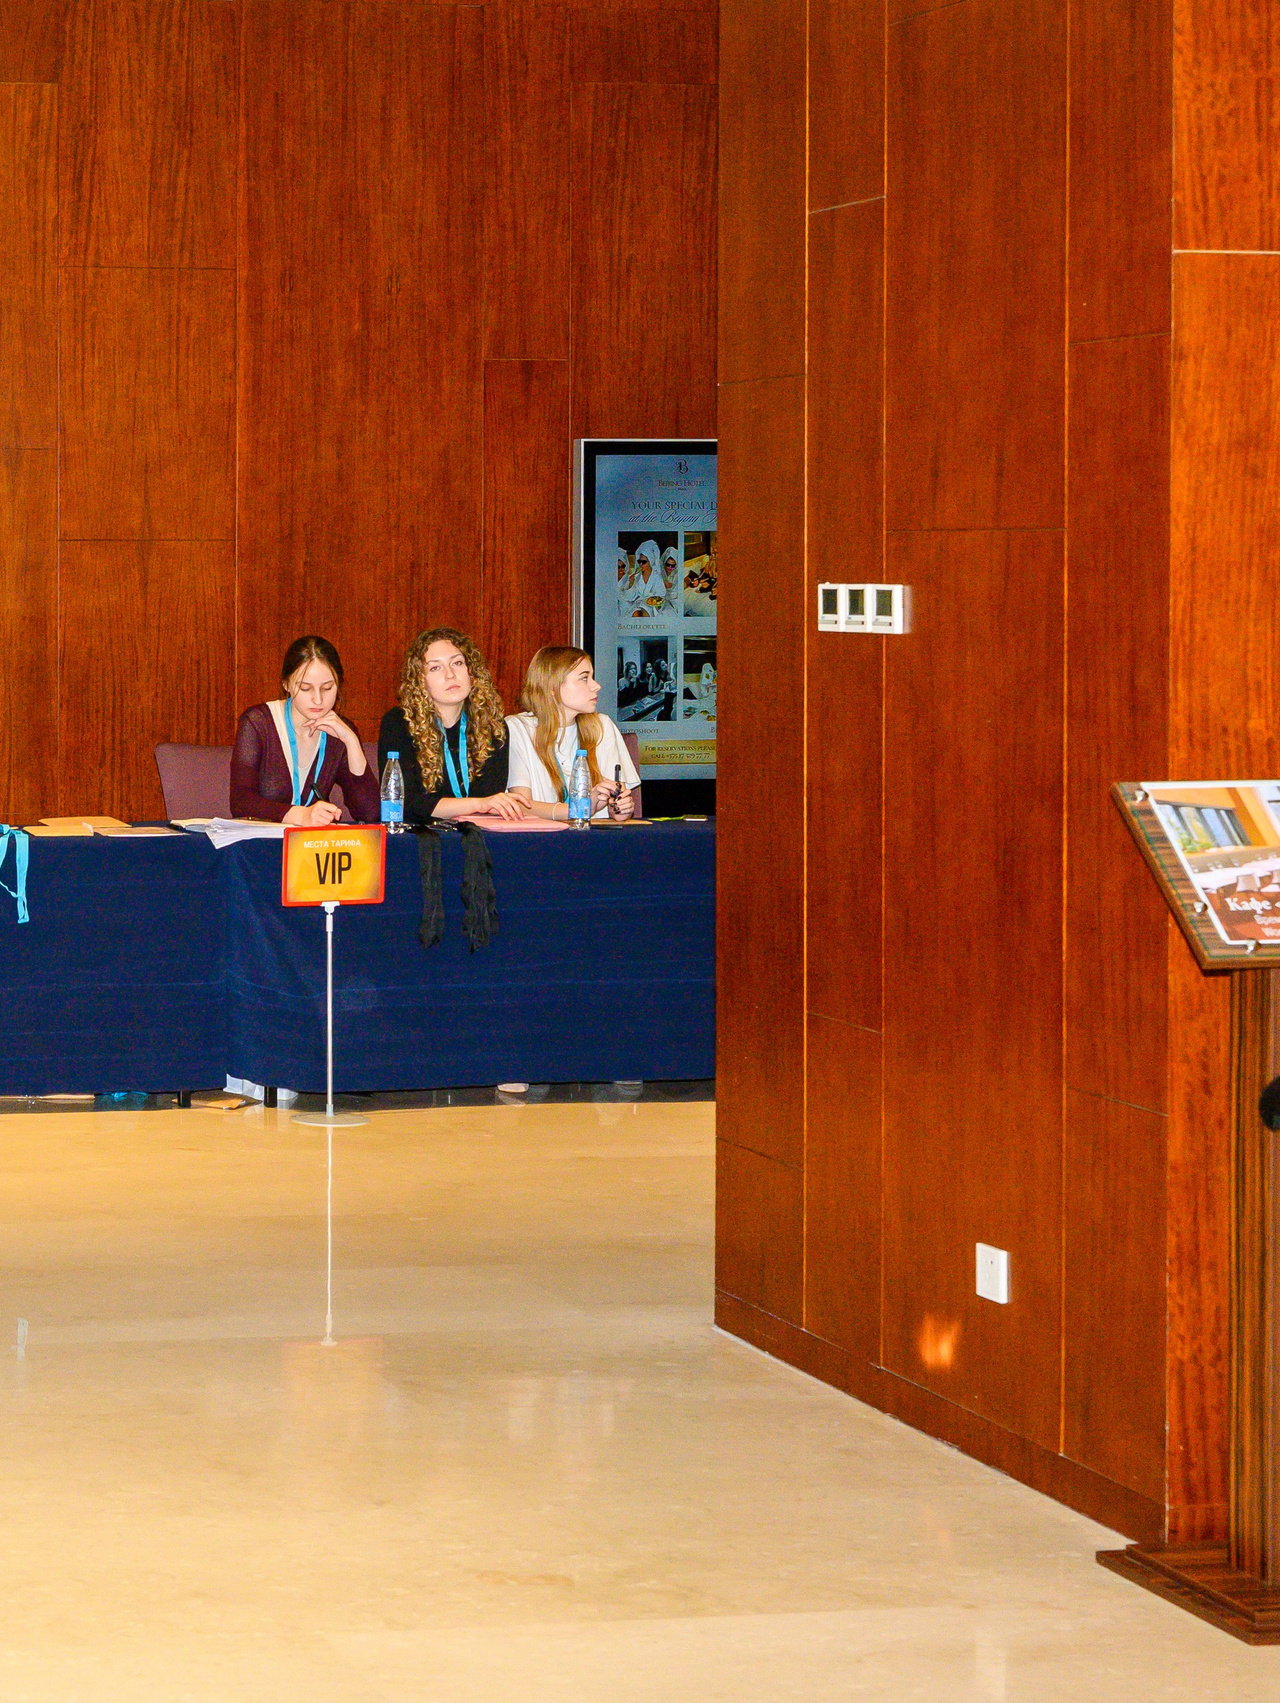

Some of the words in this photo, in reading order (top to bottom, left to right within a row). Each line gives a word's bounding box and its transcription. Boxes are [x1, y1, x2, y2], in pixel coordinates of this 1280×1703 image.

[631, 501, 661, 510] YOUR
[665, 501, 707, 510] SPECIAL
[641, 511, 658, 522] the
[660, 509, 700, 528] Beijing
[304, 841, 329, 849] МЕСТА
[331, 839, 361, 848] ТАРИФА
[315, 852, 352, 885] VIP
[1224, 897, 1272, 915] Кафе
